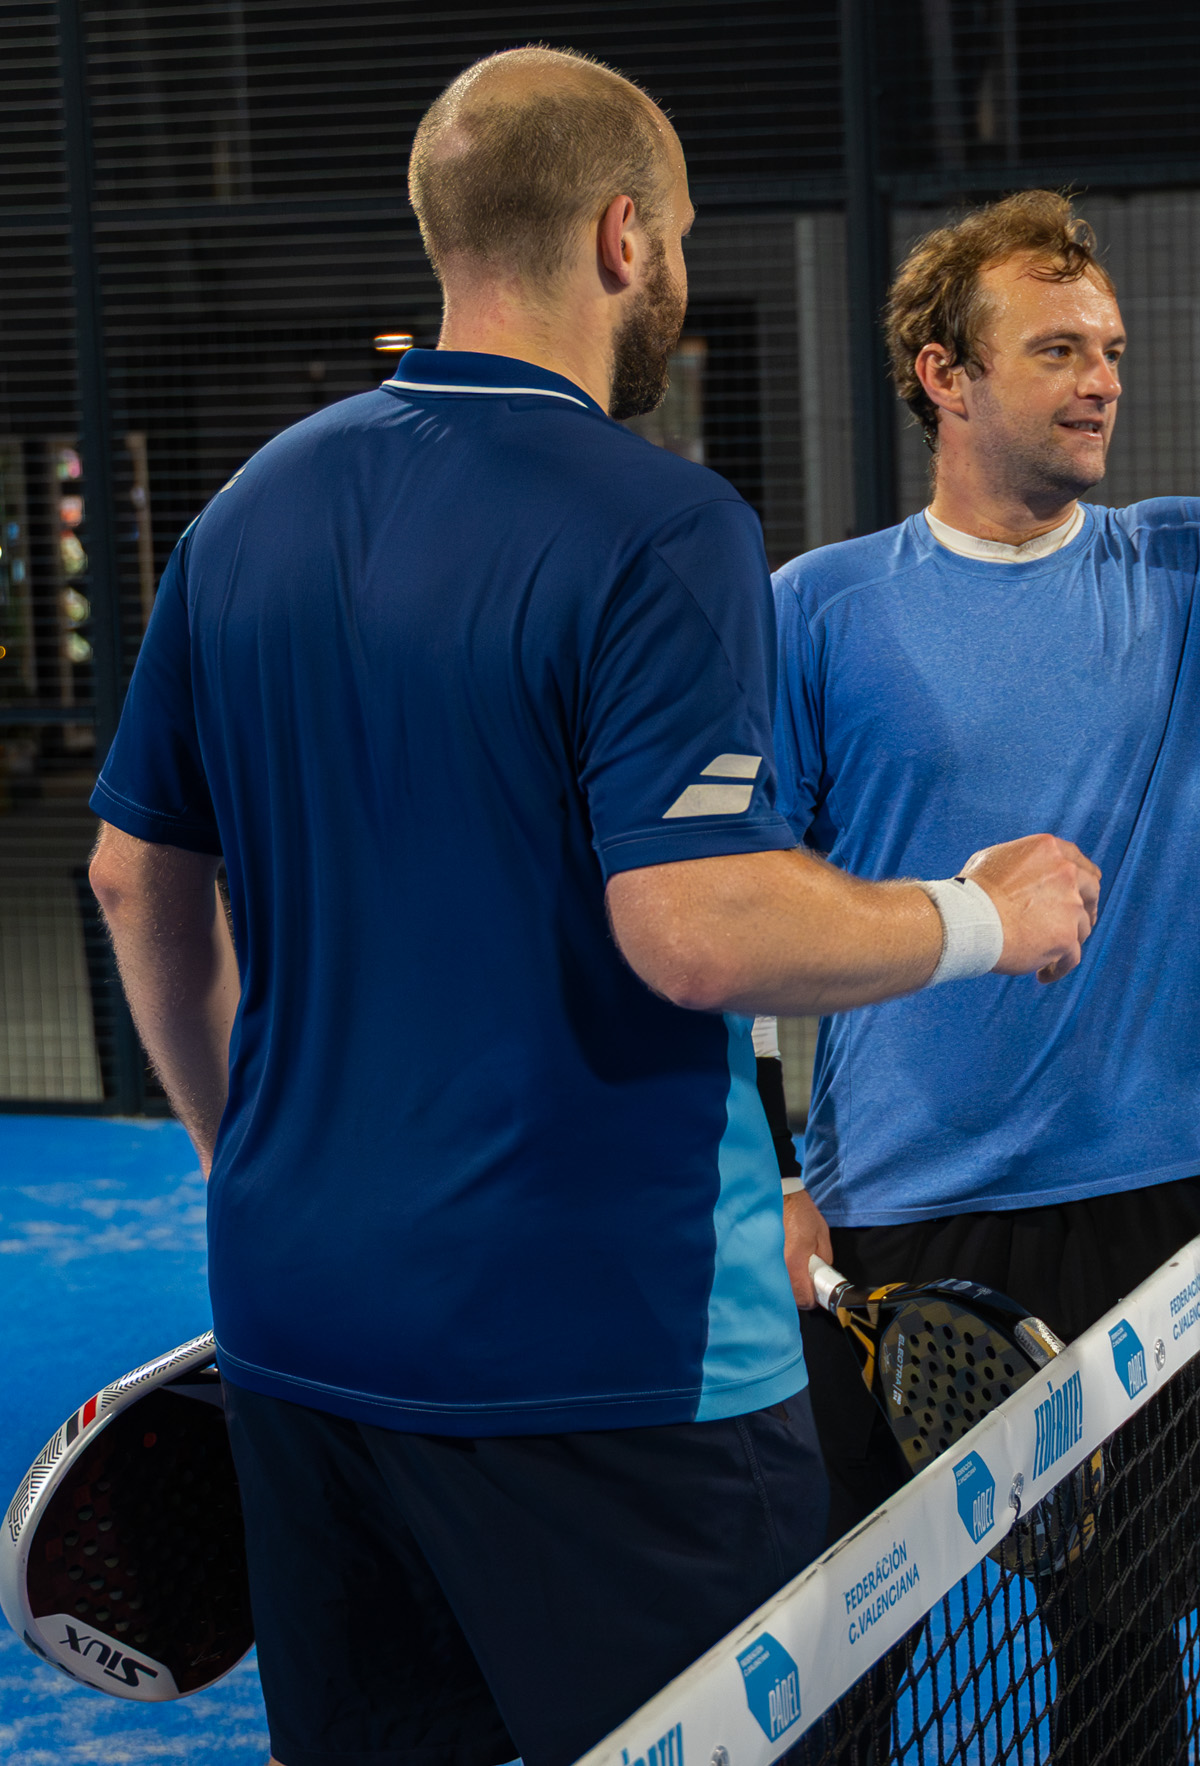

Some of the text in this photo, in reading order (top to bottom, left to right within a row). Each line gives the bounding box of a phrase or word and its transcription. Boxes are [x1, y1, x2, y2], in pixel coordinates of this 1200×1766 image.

[972, 1486, 993, 1541] PÁDEL
[843, 1538, 908, 1615] FEDERACIÓN
[848, 1562, 920, 1645] C.VALENCIANA
[768, 1670, 800, 1739] PÁDEL
